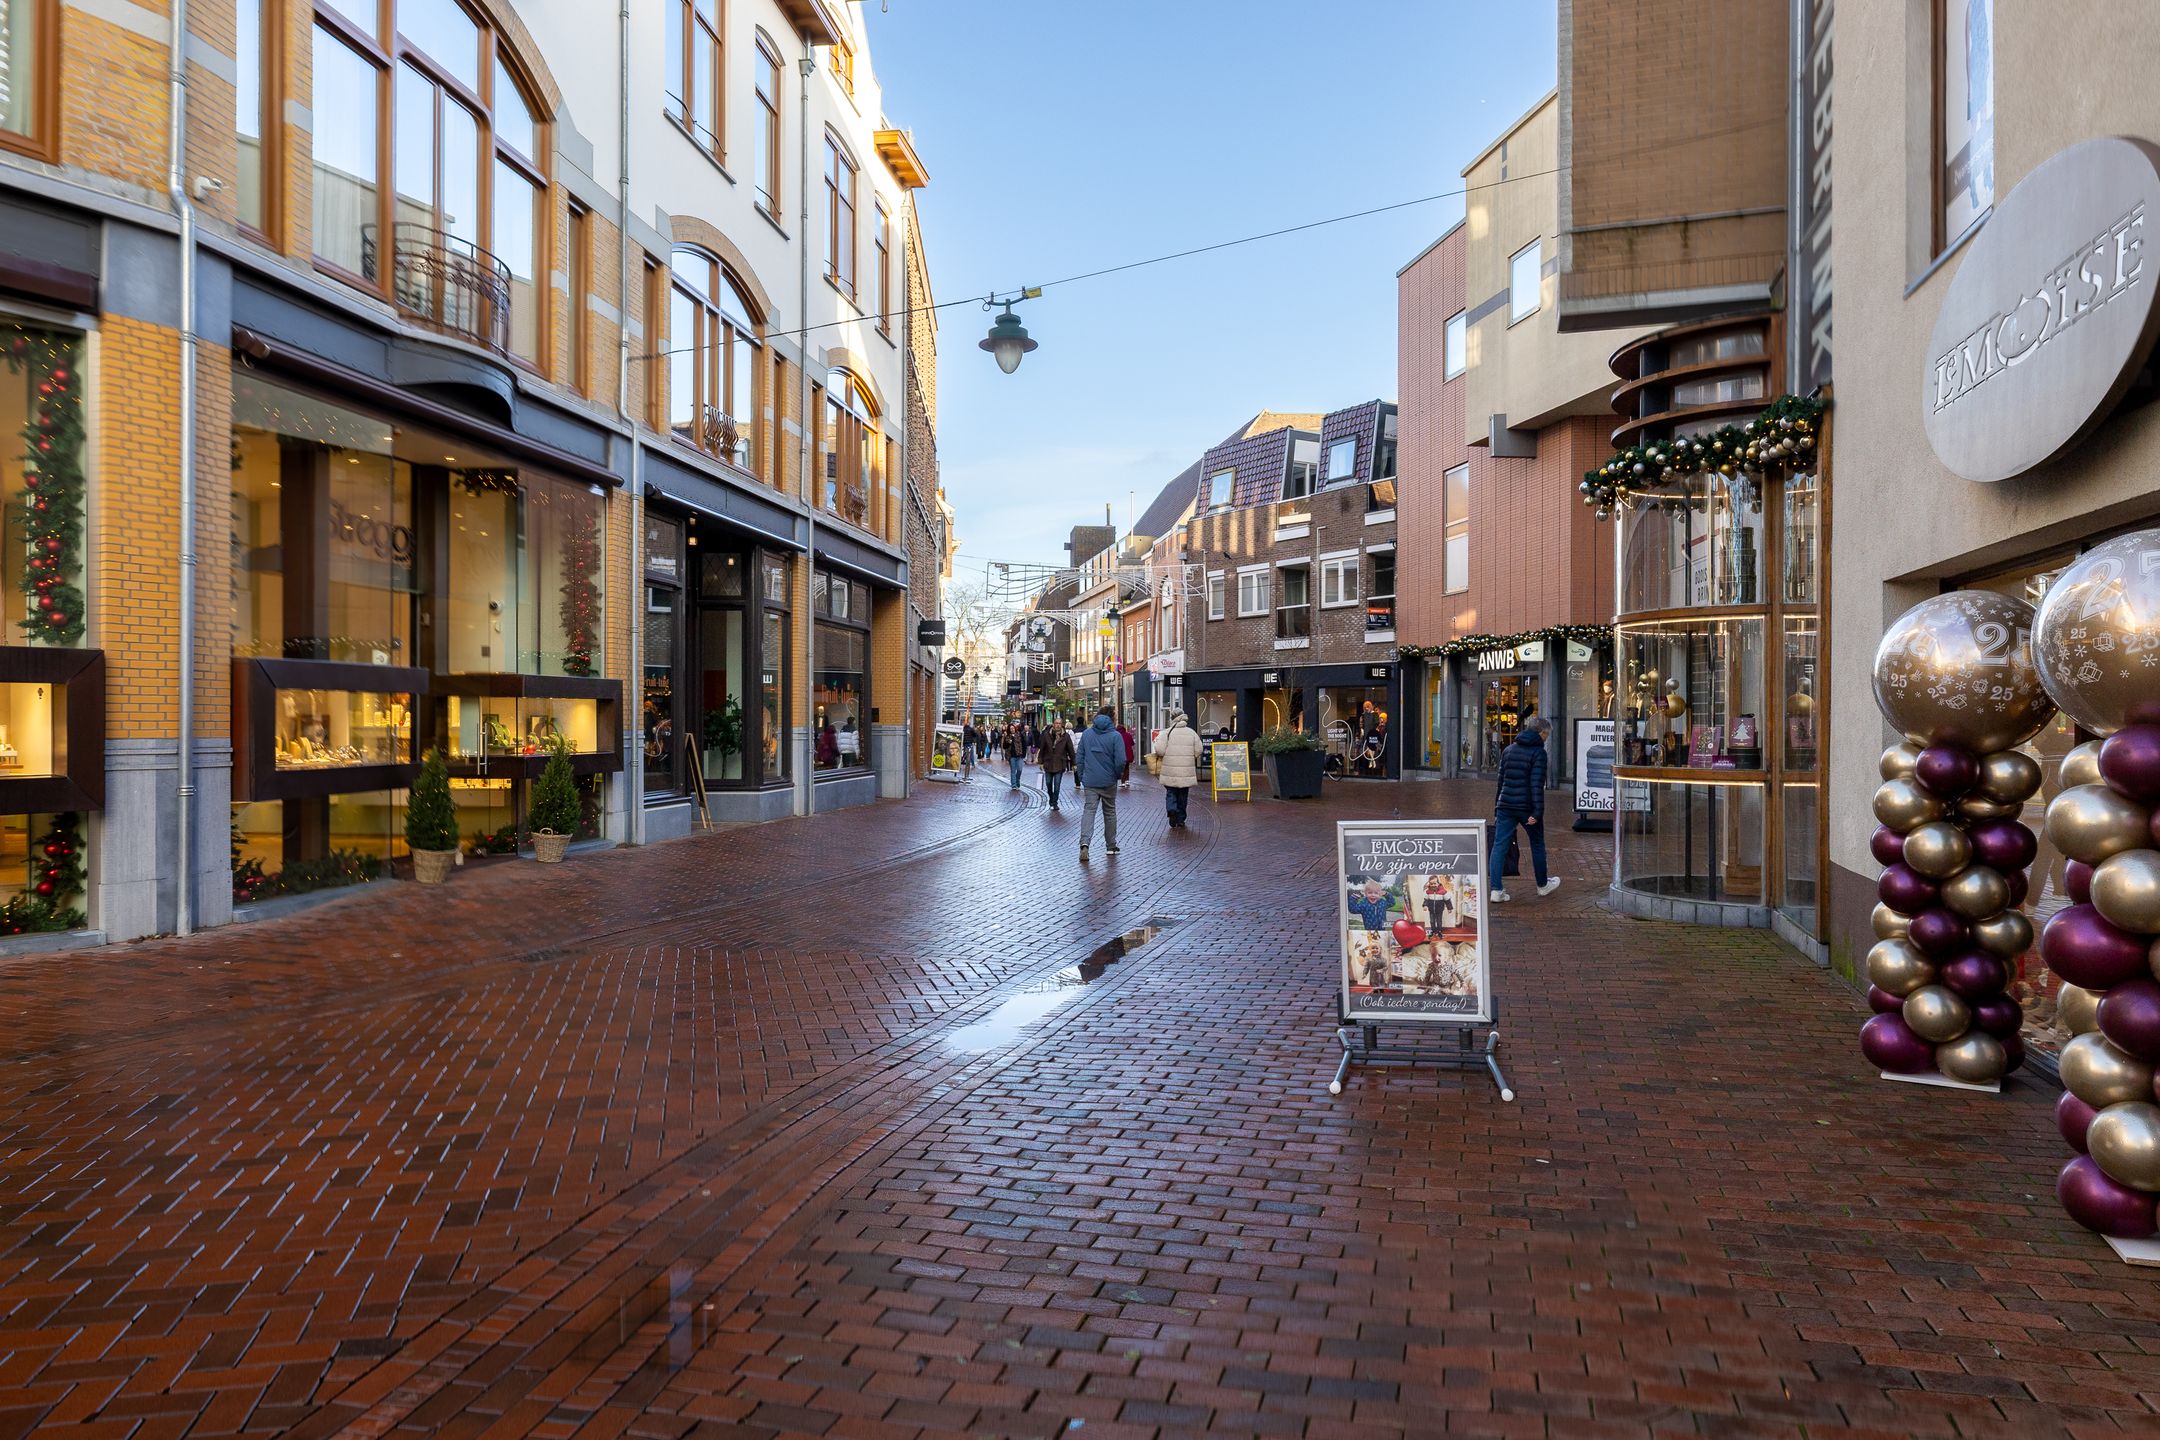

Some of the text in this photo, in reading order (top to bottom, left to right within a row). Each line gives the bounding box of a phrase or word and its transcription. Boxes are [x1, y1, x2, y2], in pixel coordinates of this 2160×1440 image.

[1811, 0, 1834, 378] EBRINK
[2070, 627, 2087, 640] 25
[1478, 649, 1515, 671] ANWB
[1264, 673, 1278, 683] WE
[1372, 668, 1386, 677] WE
[1170, 677, 1183, 685] WE
[1890, 673, 1907, 688] 25
[1990, 686, 2014, 701] 25
[1595, 725, 1615, 733] MAGA
[1591, 734, 1615, 742] UITVER
[1582, 790, 1598, 800] de
[1357, 854, 1459, 875] We zijn open!
[1360, 995, 1384, 1008] (Ook
[1387, 997, 1419, 1008] iedere
